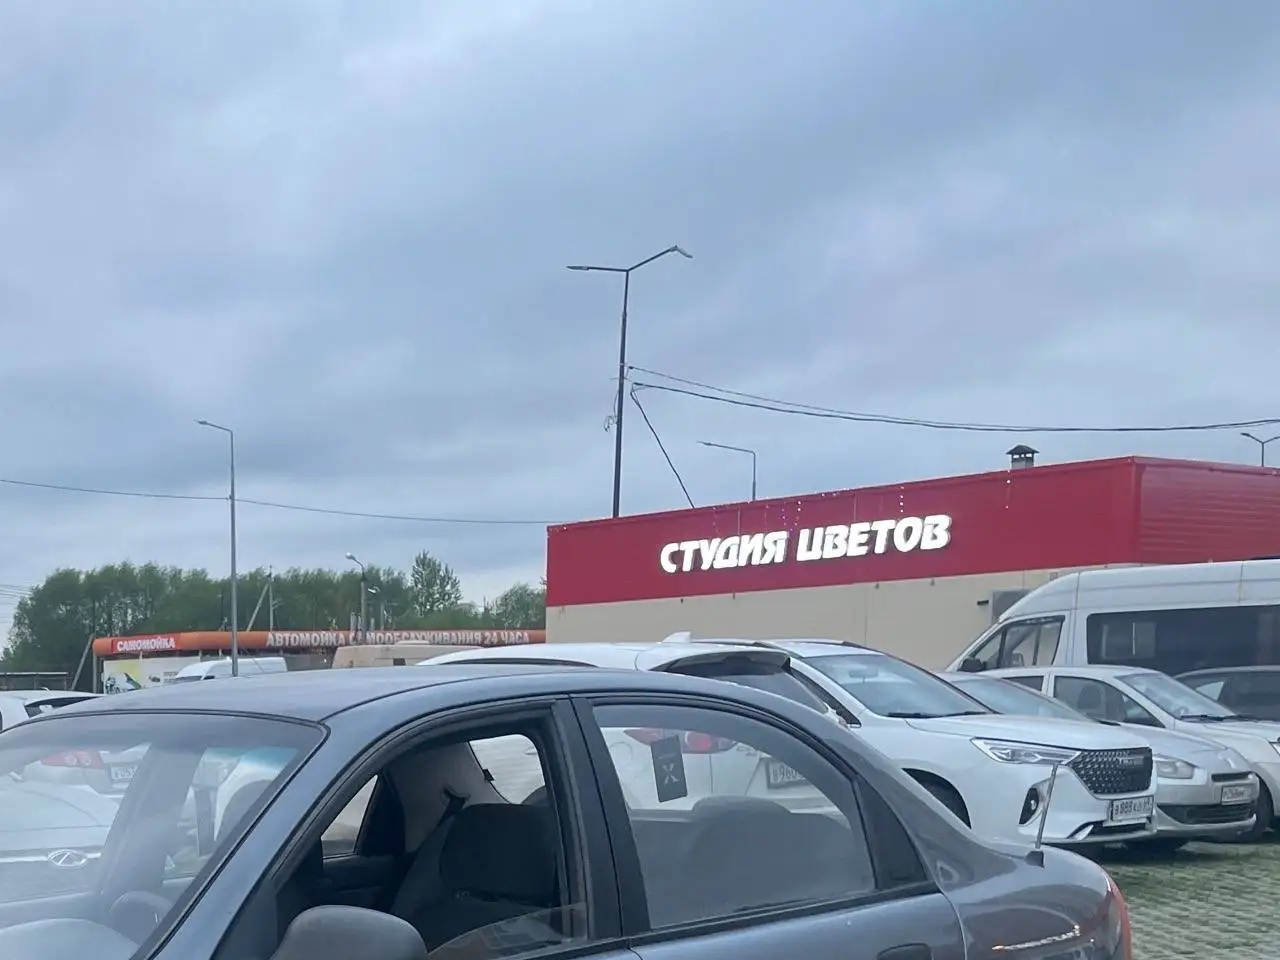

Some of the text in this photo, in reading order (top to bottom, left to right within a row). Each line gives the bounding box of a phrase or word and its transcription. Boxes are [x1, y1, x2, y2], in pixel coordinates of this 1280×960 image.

[660, 514, 952, 574] СТУДИЯ ЦВЕТОВ
[117, 636, 176, 652] САМОМОЙКА
[266, 631, 346, 647] АВТОМОЙКА
[484, 632, 498, 644] 24
[501, 631, 530, 645] ЧАСА
